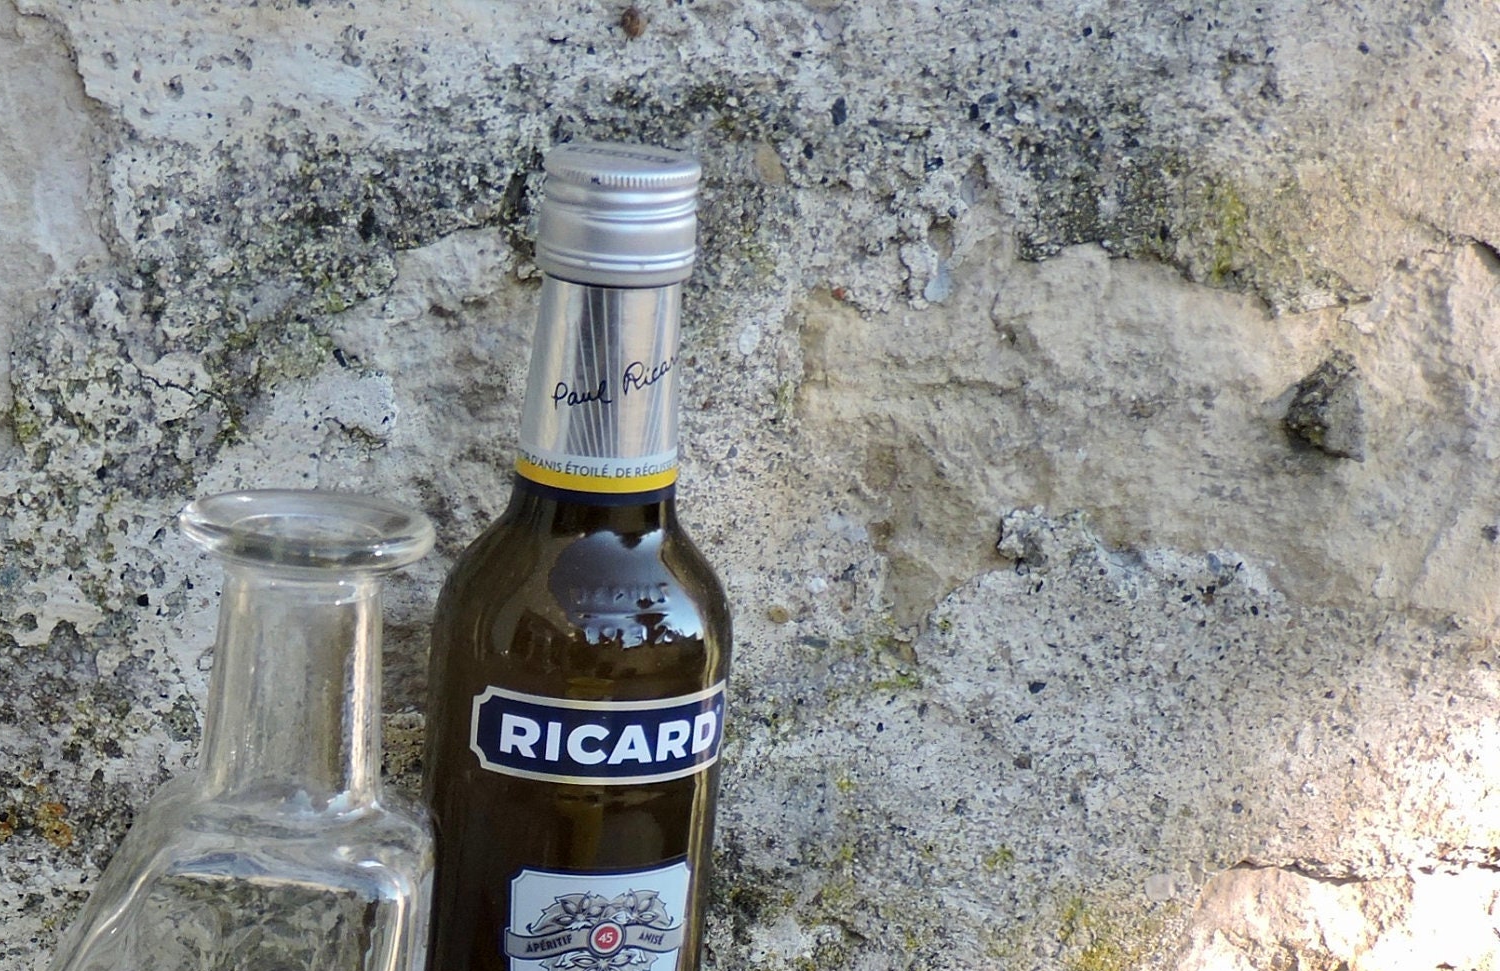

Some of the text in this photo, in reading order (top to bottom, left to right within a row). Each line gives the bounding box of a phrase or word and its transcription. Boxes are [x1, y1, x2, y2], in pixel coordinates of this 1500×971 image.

[551, 382, 612, 410] Paul
[615, 468, 631, 478] DE
[500, 711, 717, 765] RICARD
[525, 933, 573, 953] APÉRITIF
[598, 931, 613, 944] 45
